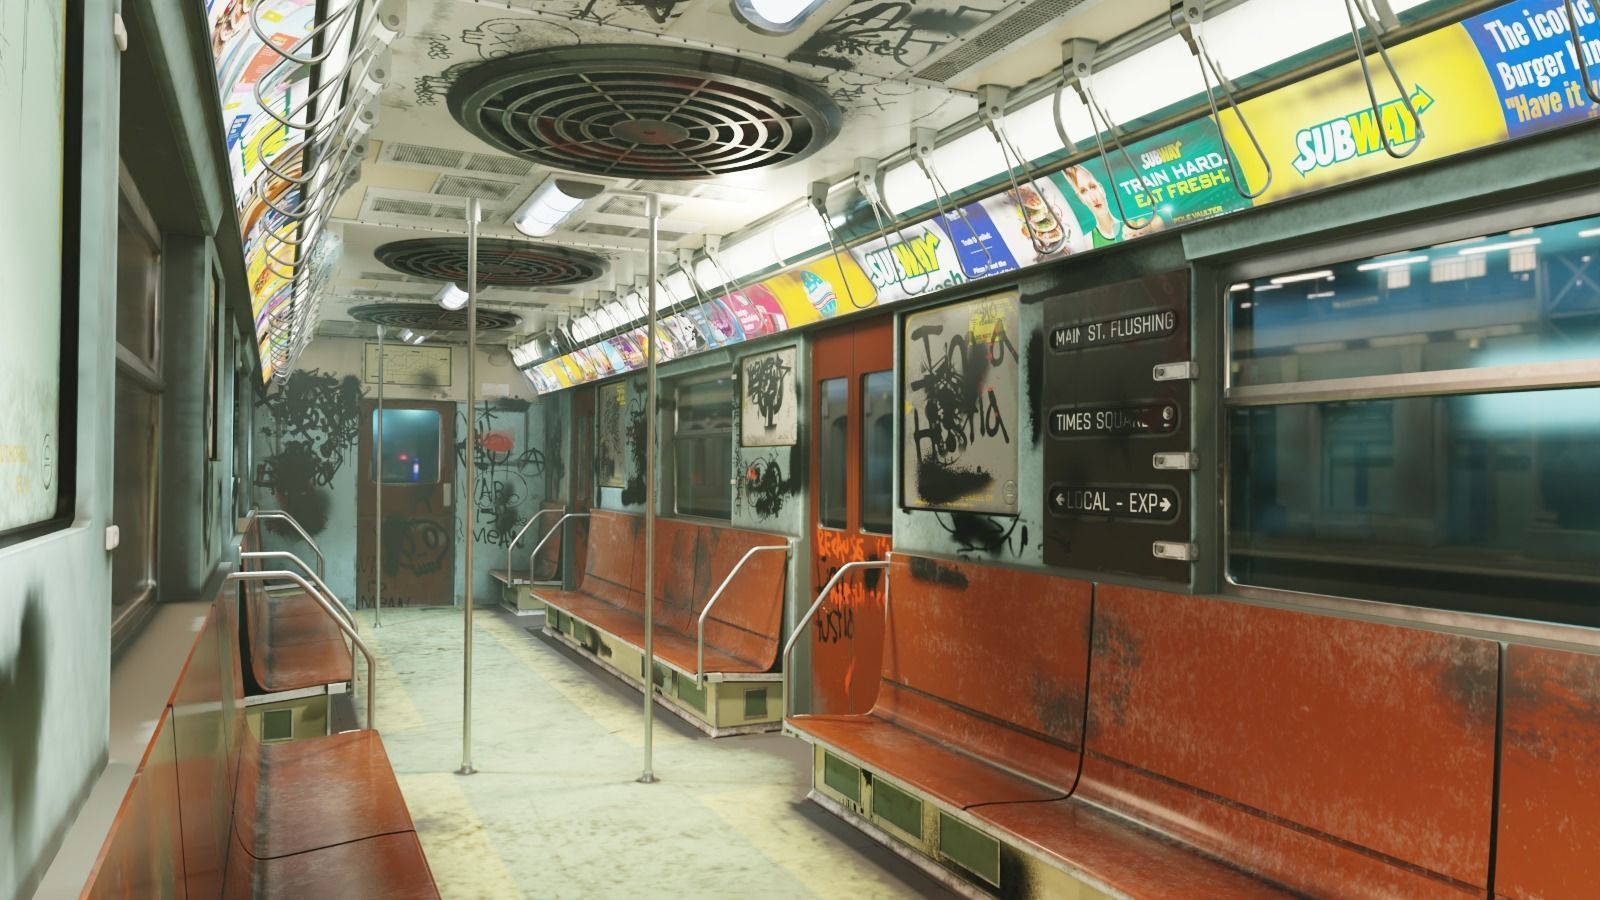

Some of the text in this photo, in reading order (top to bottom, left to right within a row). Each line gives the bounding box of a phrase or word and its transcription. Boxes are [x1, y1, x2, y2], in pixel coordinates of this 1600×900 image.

[1483, 19, 1530, 53] The
[1496, 50, 1566, 91] Burger
[1505, 91, 1563, 122] "Have
[1563, 80, 1585, 109] it
[1292, 84, 1434, 178] SUBWAY
[1141, 140, 1182, 170] SUBWAY
[1119, 152, 1229, 195] TRAIN HARD.
[1134, 187, 1164, 208] EAT
[865, 225, 941, 292] SUBWAY
[1088, 323, 1106, 341] ST.
[1110, 311, 1174, 338] FLUSHING
[1056, 412, 1092, 431] TIMES
[1067, 488, 1110, 511] LOCAL
[1129, 492, 1158, 513] EXP
